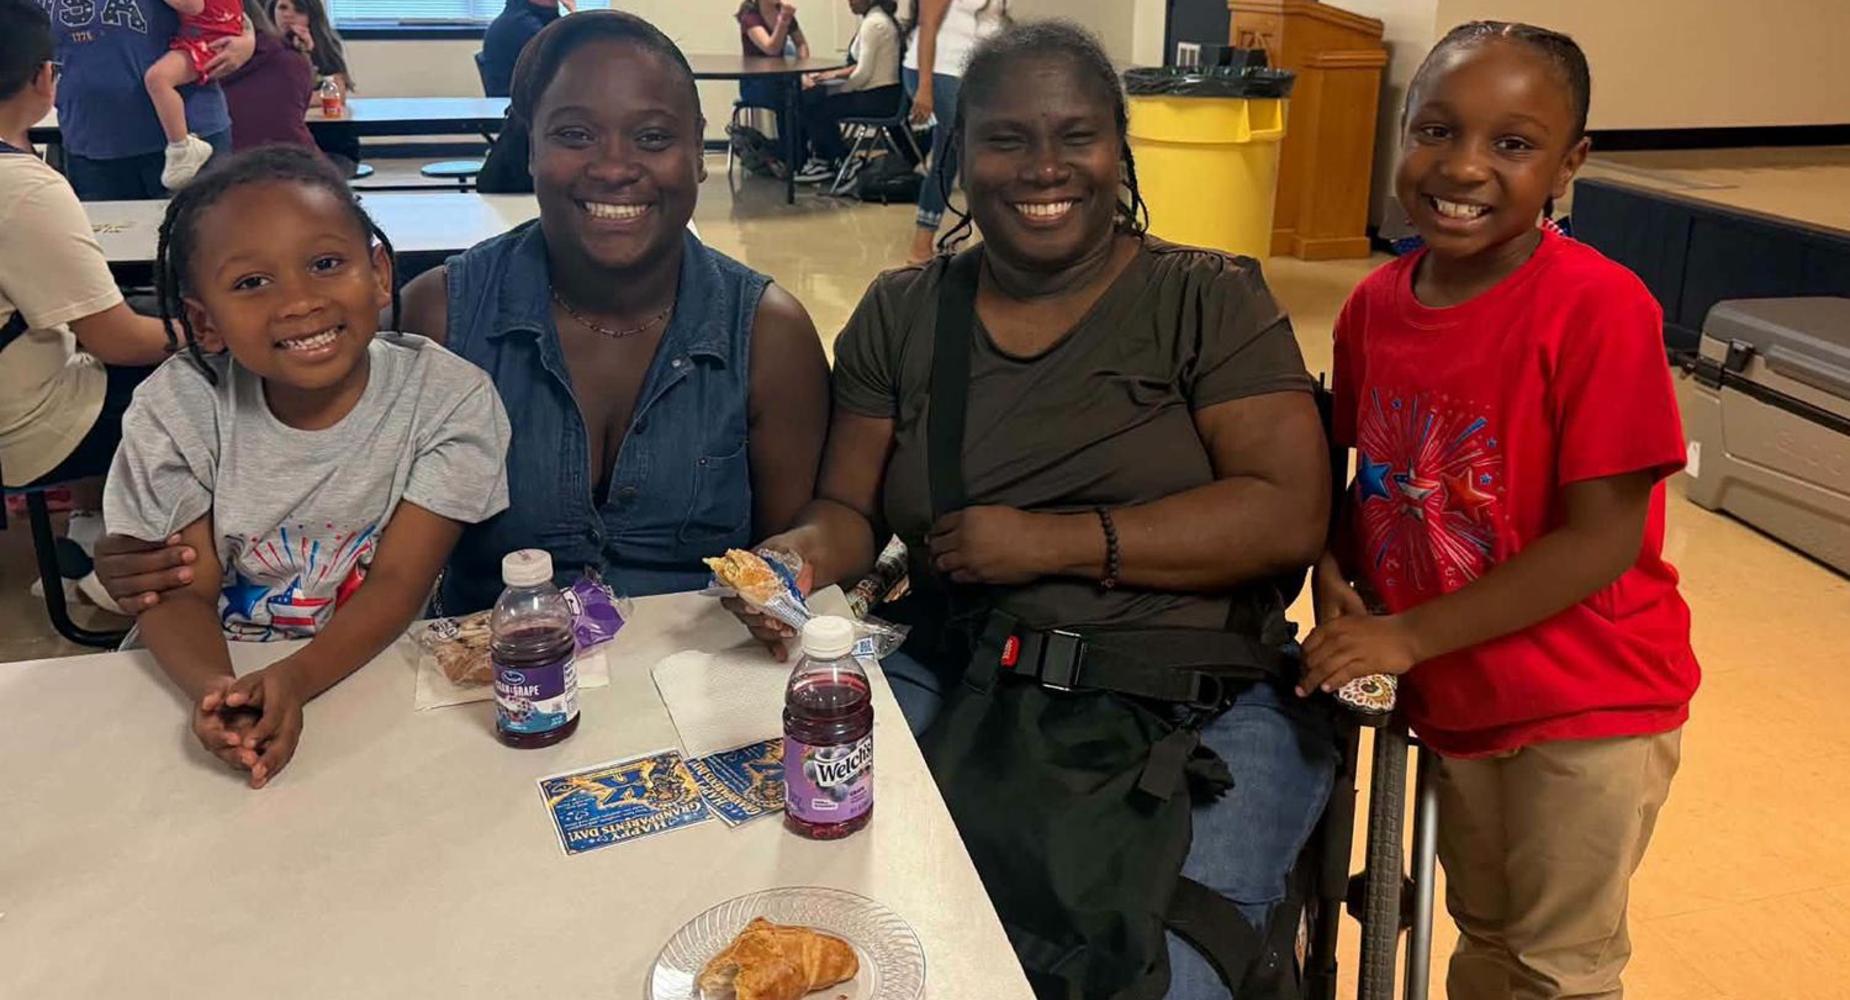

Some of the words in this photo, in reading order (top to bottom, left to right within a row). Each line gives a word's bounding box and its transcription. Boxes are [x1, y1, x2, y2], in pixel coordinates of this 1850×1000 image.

[37, 0, 148, 34] SA
[816, 743, 872, 783] Welch's
[566, 827, 600, 842] DAY!
[601, 802, 701, 836] GRANDPARENTS
[610, 820, 667, 841] HAPPY
